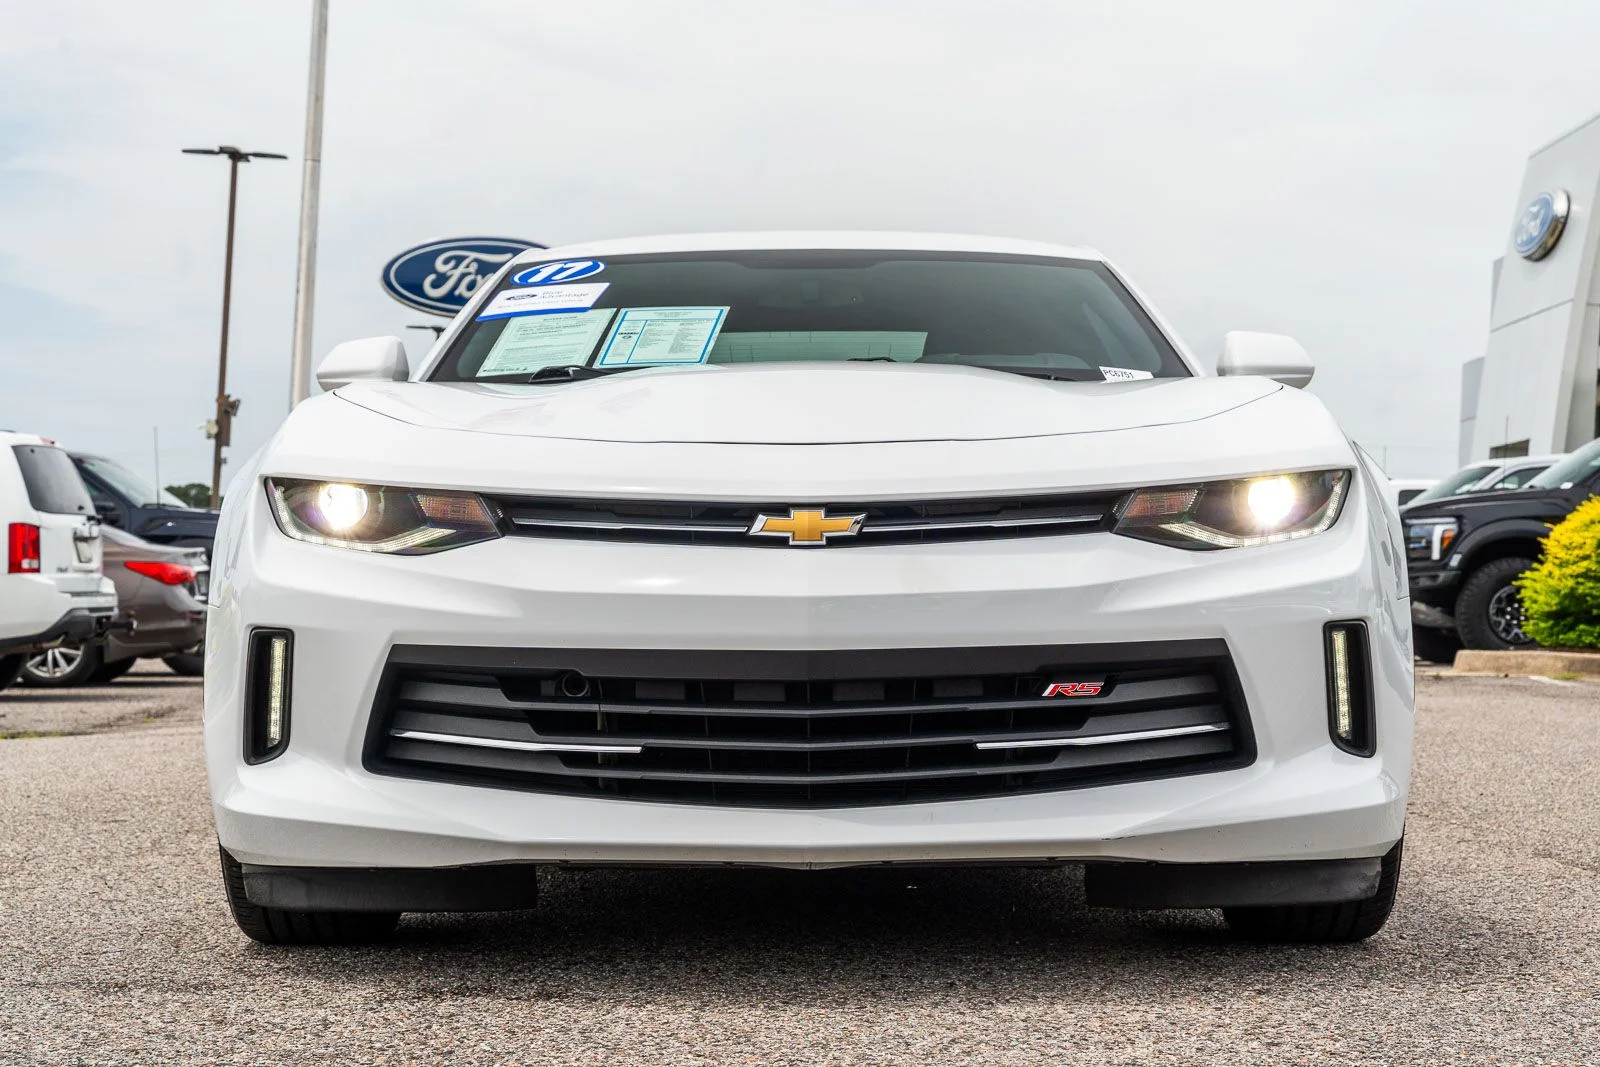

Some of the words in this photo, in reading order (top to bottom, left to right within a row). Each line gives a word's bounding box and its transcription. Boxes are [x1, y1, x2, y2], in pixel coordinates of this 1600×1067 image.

[422, 250, 514, 299] Fo
[527, 260, 594, 283] 17
[1041, 681, 1105, 697] RS
